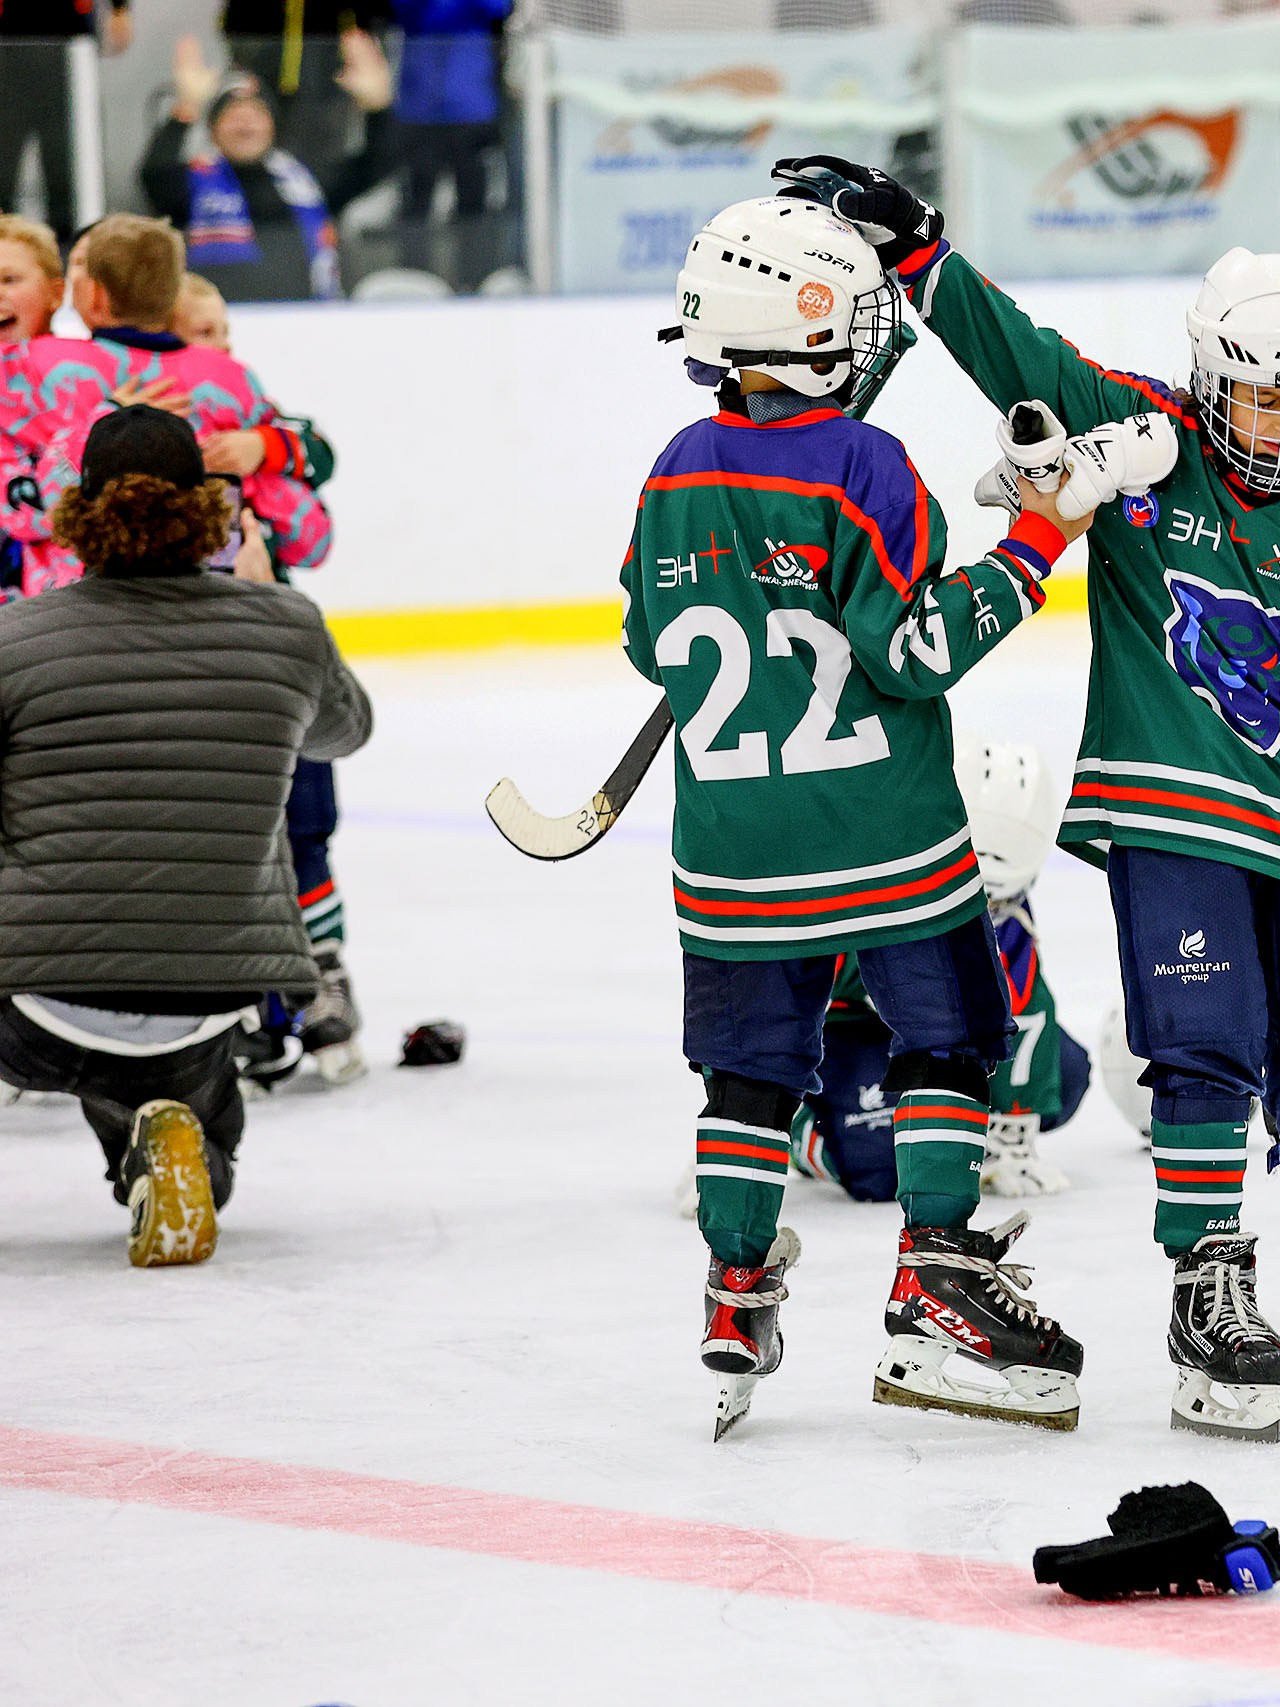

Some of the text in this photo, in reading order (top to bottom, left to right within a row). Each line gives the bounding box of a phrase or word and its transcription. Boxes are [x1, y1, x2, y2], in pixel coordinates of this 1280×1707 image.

[803, 248, 856, 274] JOFA
[682, 290, 702, 321] 22
[655, 604, 892, 783] 22
[577, 809, 596, 837] 22
[1181, 972, 1210, 985] group
